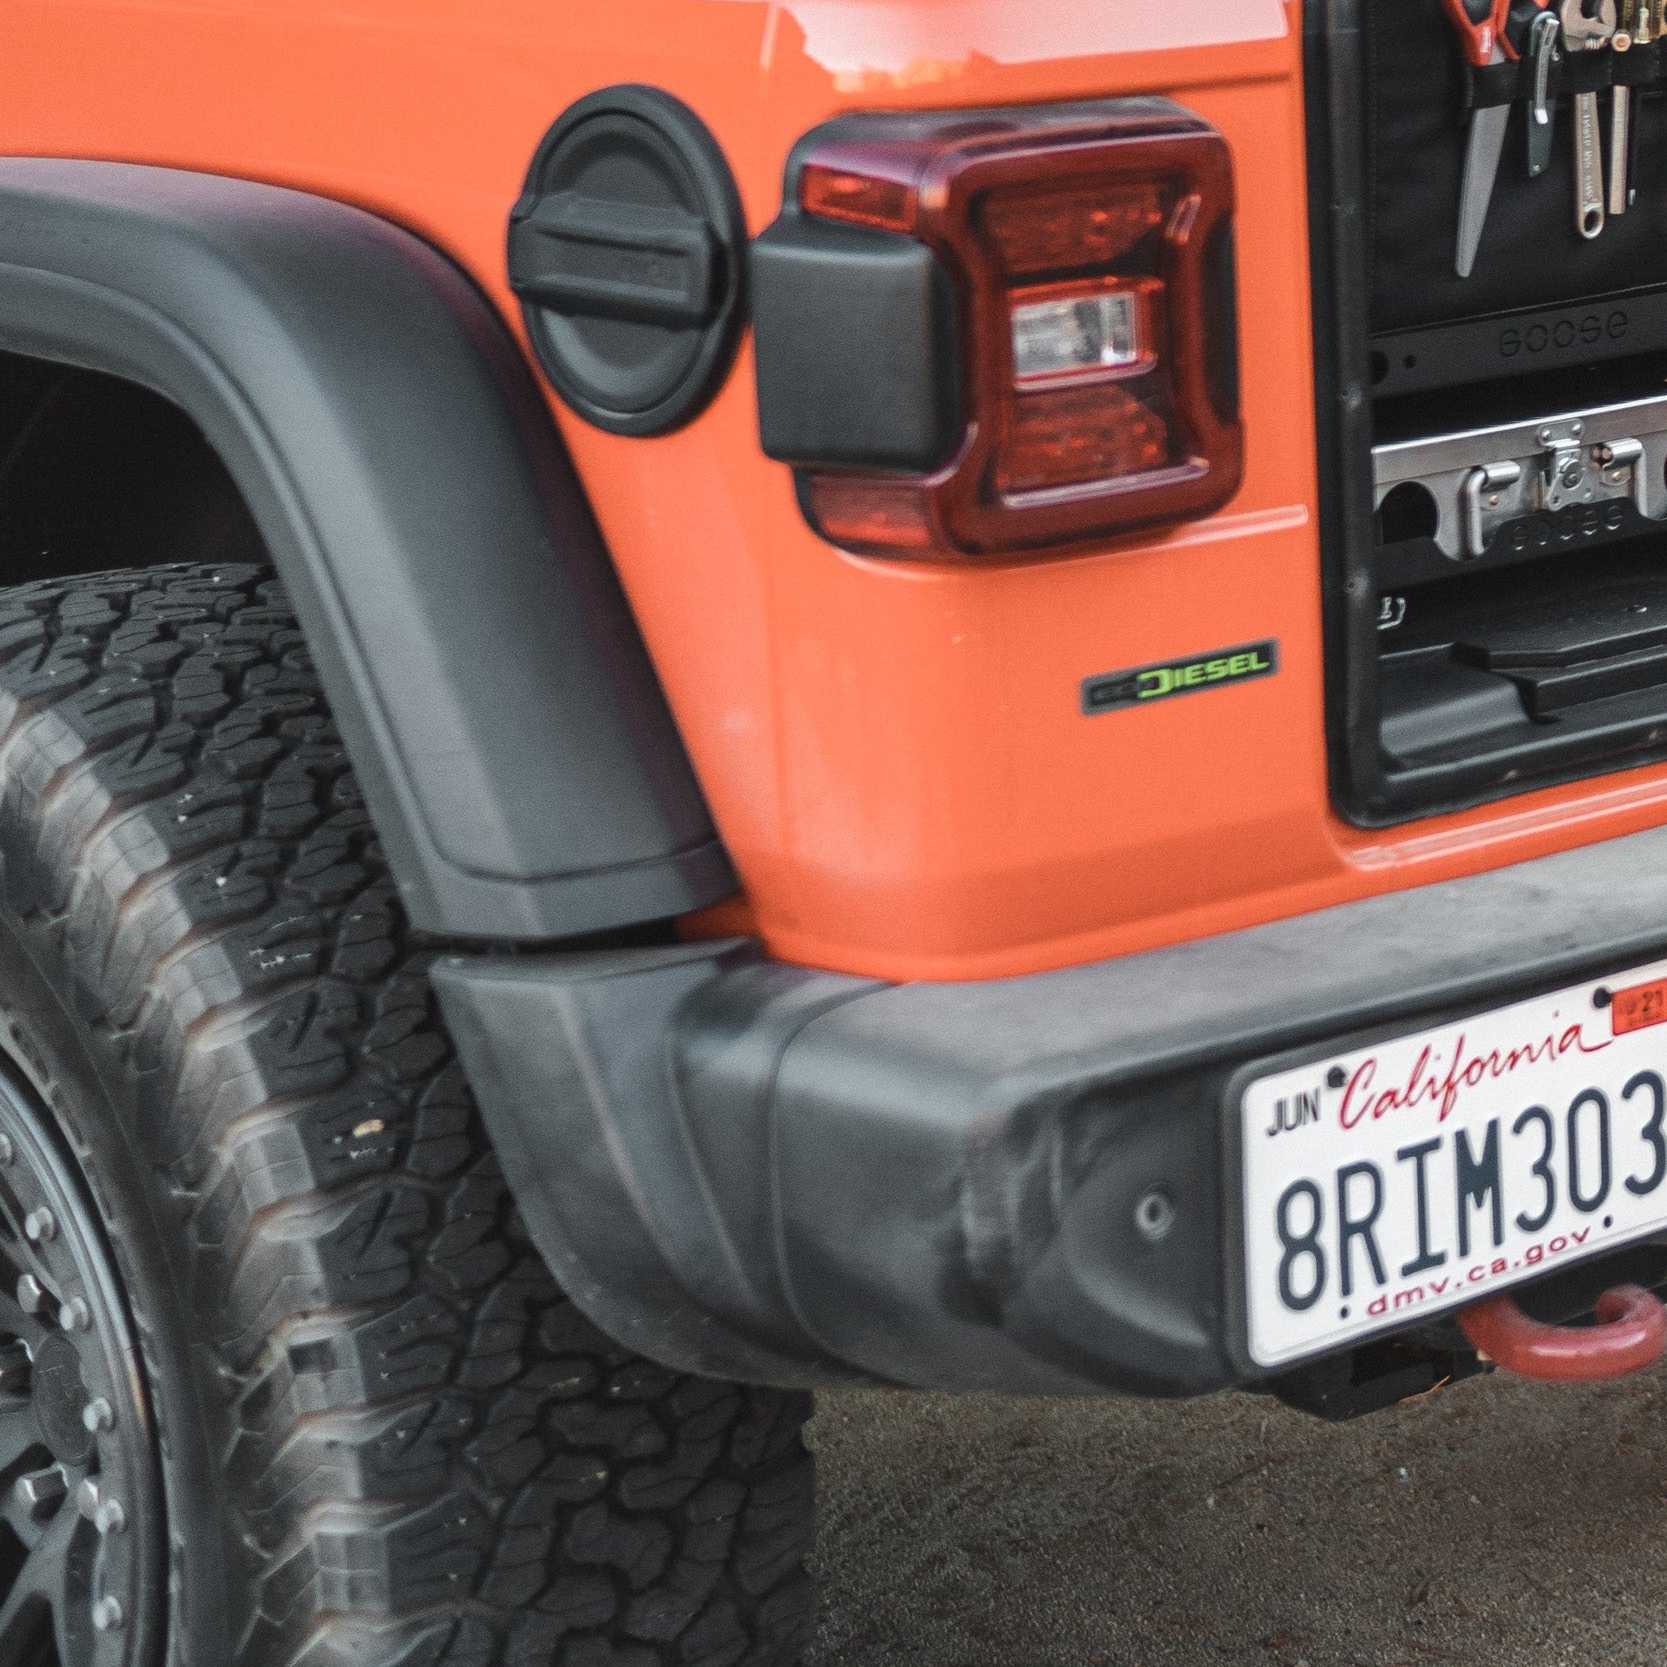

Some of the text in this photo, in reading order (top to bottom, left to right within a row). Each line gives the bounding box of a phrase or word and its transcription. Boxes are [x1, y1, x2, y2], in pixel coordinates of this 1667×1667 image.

[1137, 651, 1270, 699] DIESEL
[1266, 1010, 1615, 1137] JUN California
[1276, 1069, 1667, 1313] 8RIM303
[1366, 1225, 1592, 1318] dmv.ca.gov
